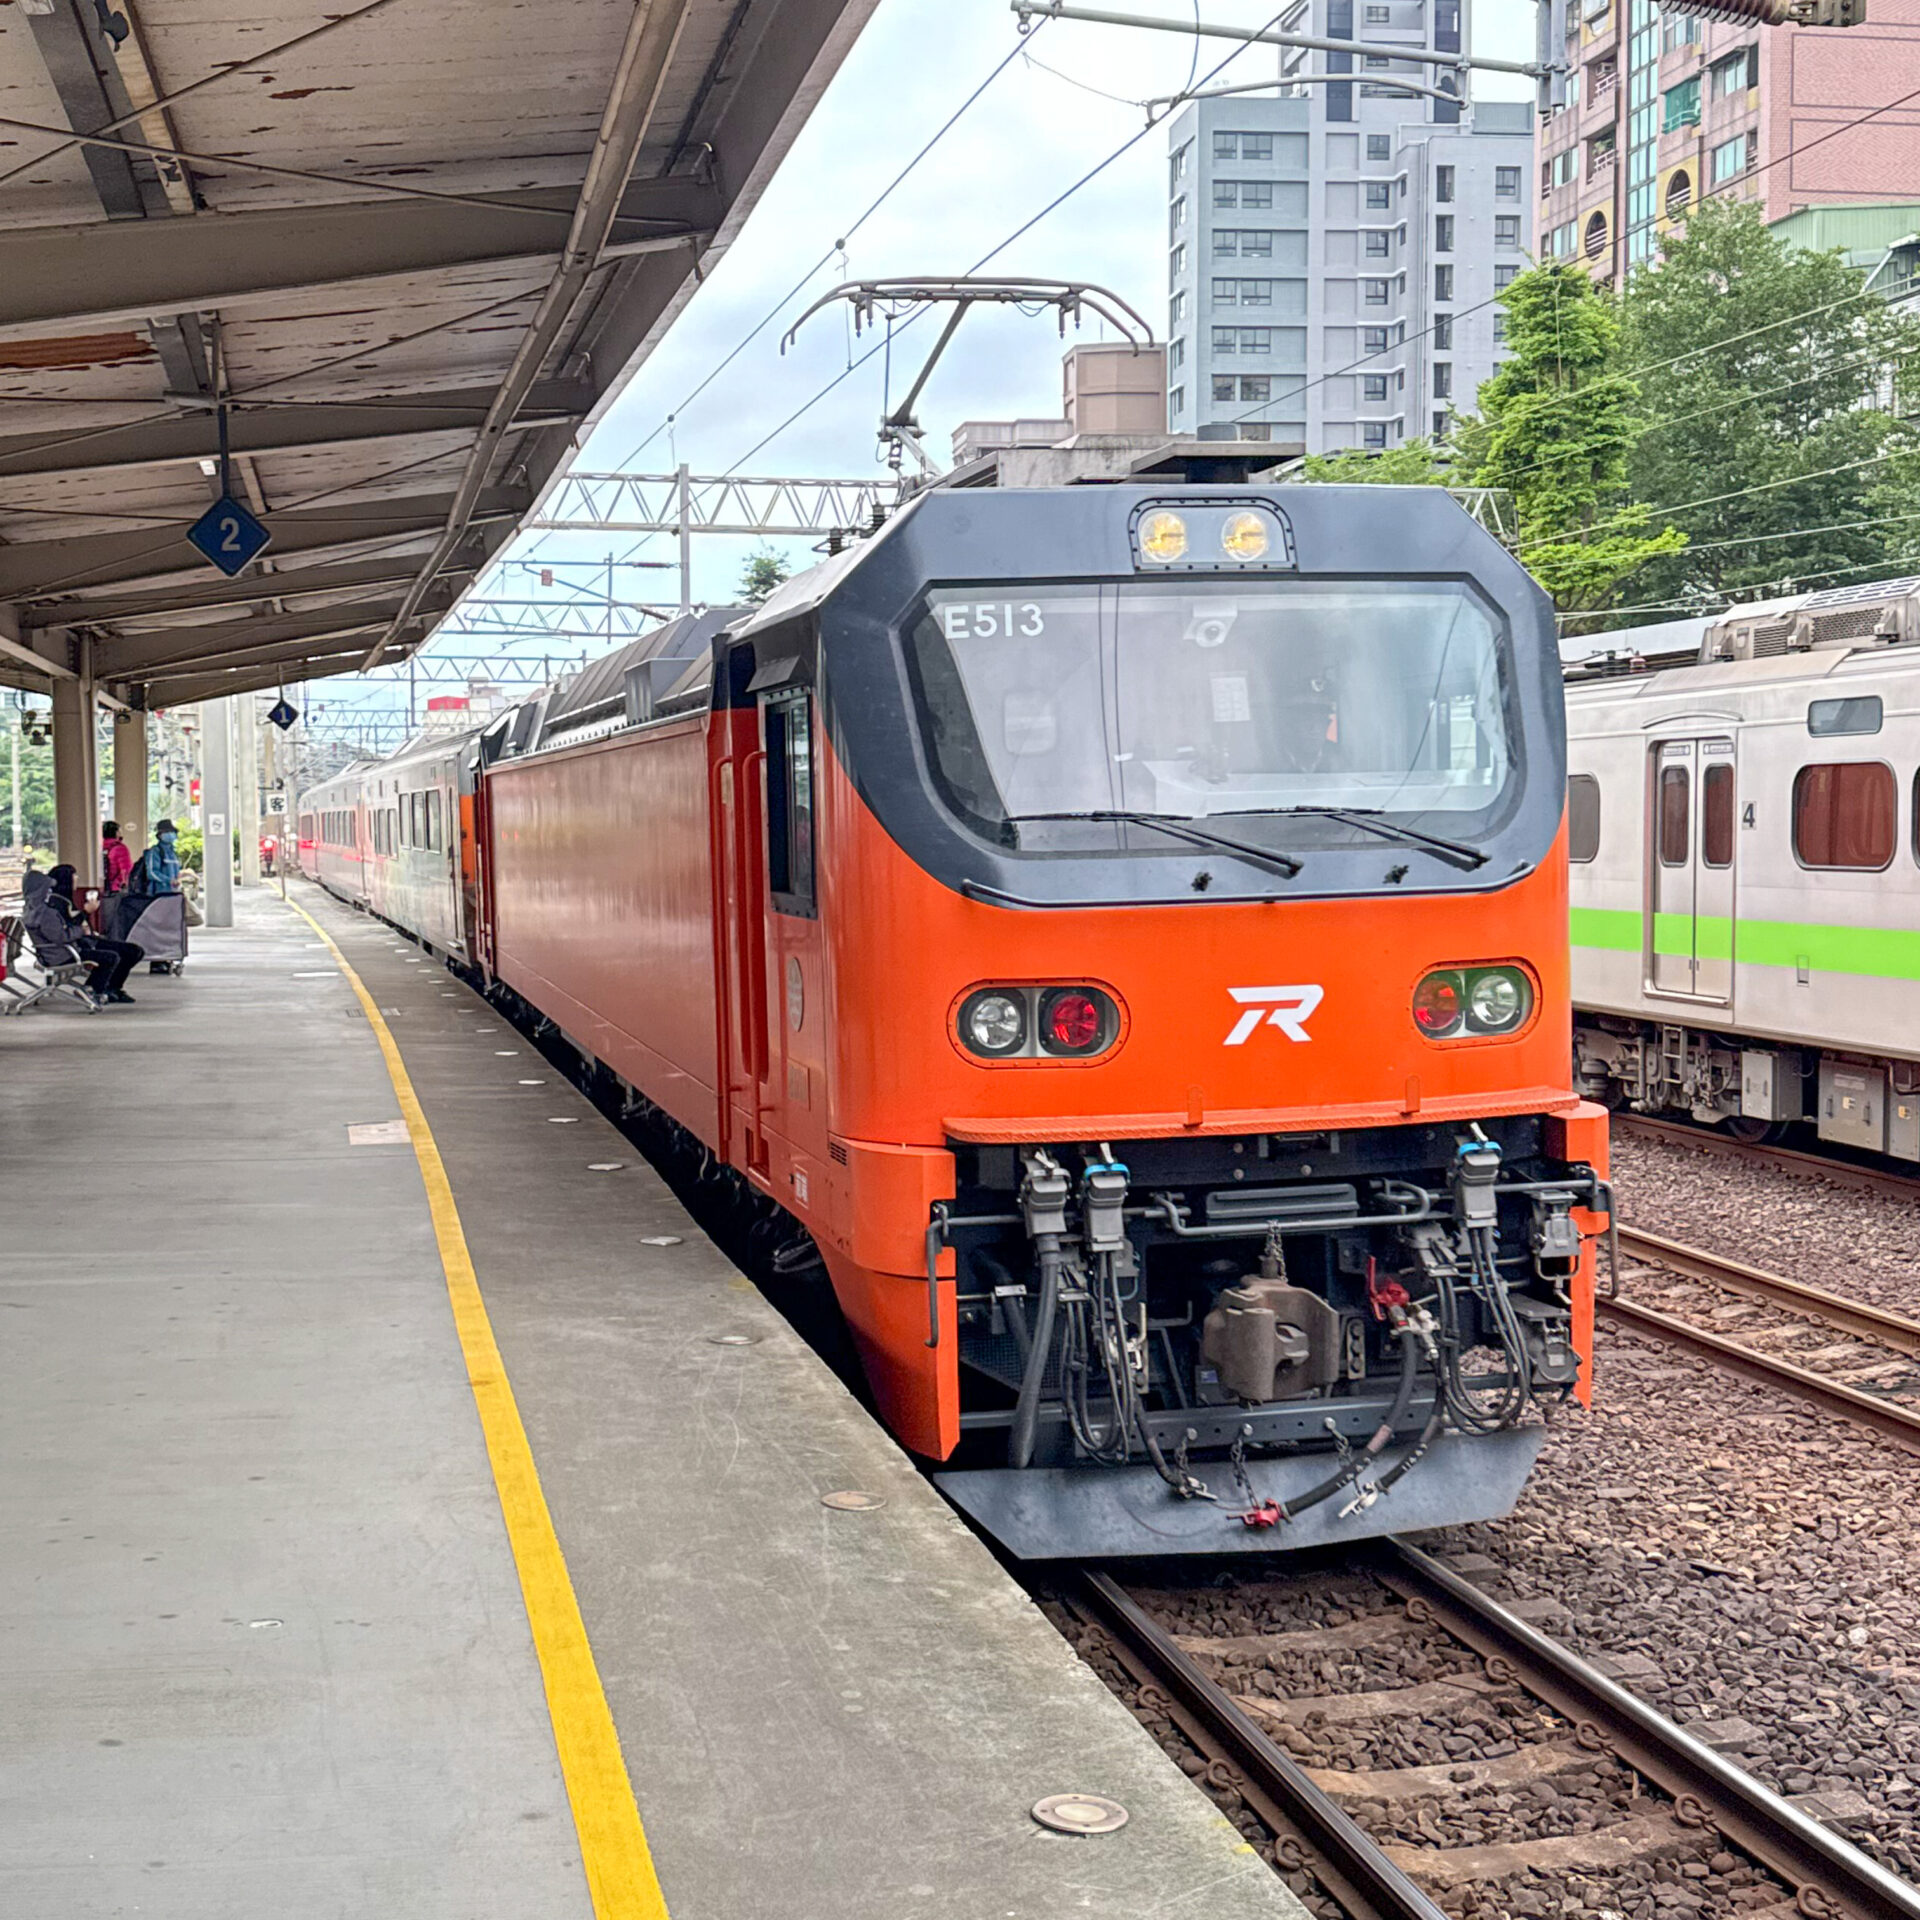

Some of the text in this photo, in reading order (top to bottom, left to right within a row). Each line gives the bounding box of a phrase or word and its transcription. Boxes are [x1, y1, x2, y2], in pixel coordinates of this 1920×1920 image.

[220, 517, 241, 551] 2
[944, 603, 1044, 639] E513
[279, 706, 290, 724] 1
[1742, 803, 1755, 828] 4
